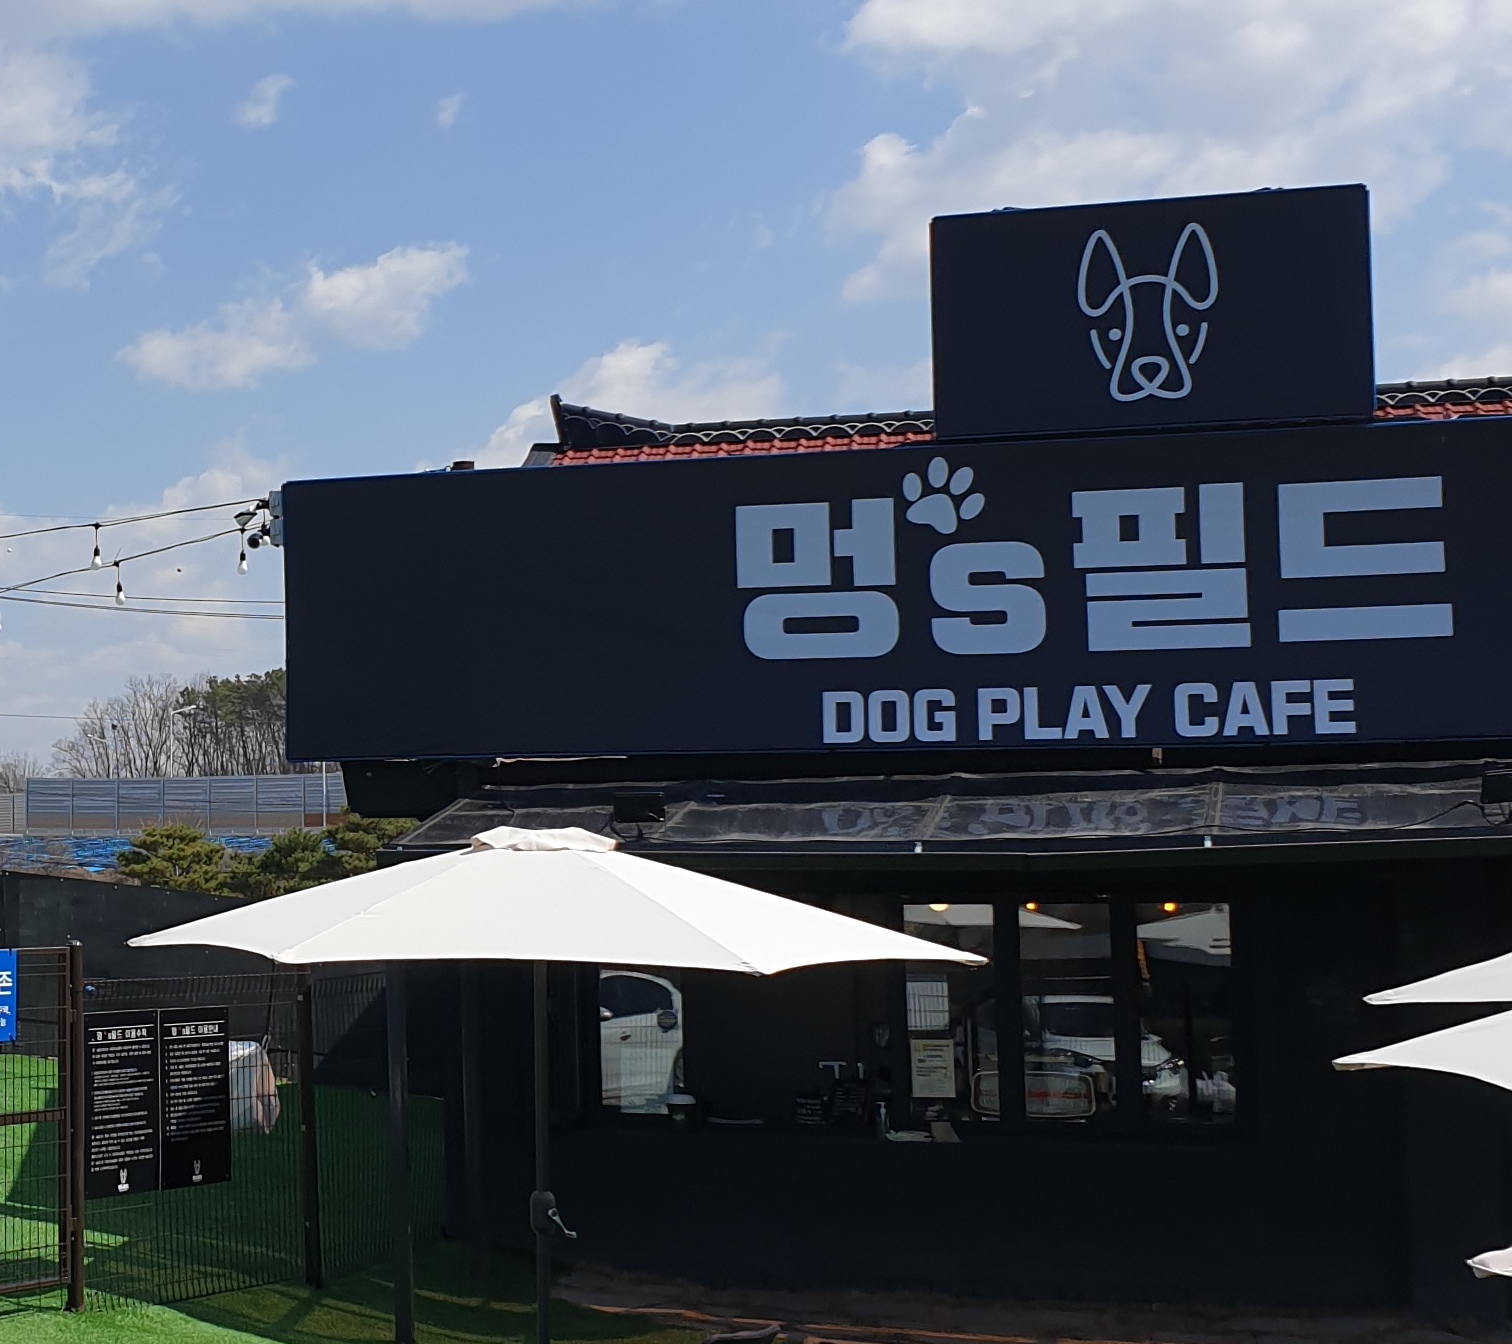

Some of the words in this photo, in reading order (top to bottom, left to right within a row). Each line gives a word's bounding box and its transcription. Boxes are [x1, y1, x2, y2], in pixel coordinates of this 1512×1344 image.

[821, 688, 957, 744] DOG
[977, 683, 1152, 741] PLAY
[1173, 678, 1358, 738] CAFE
